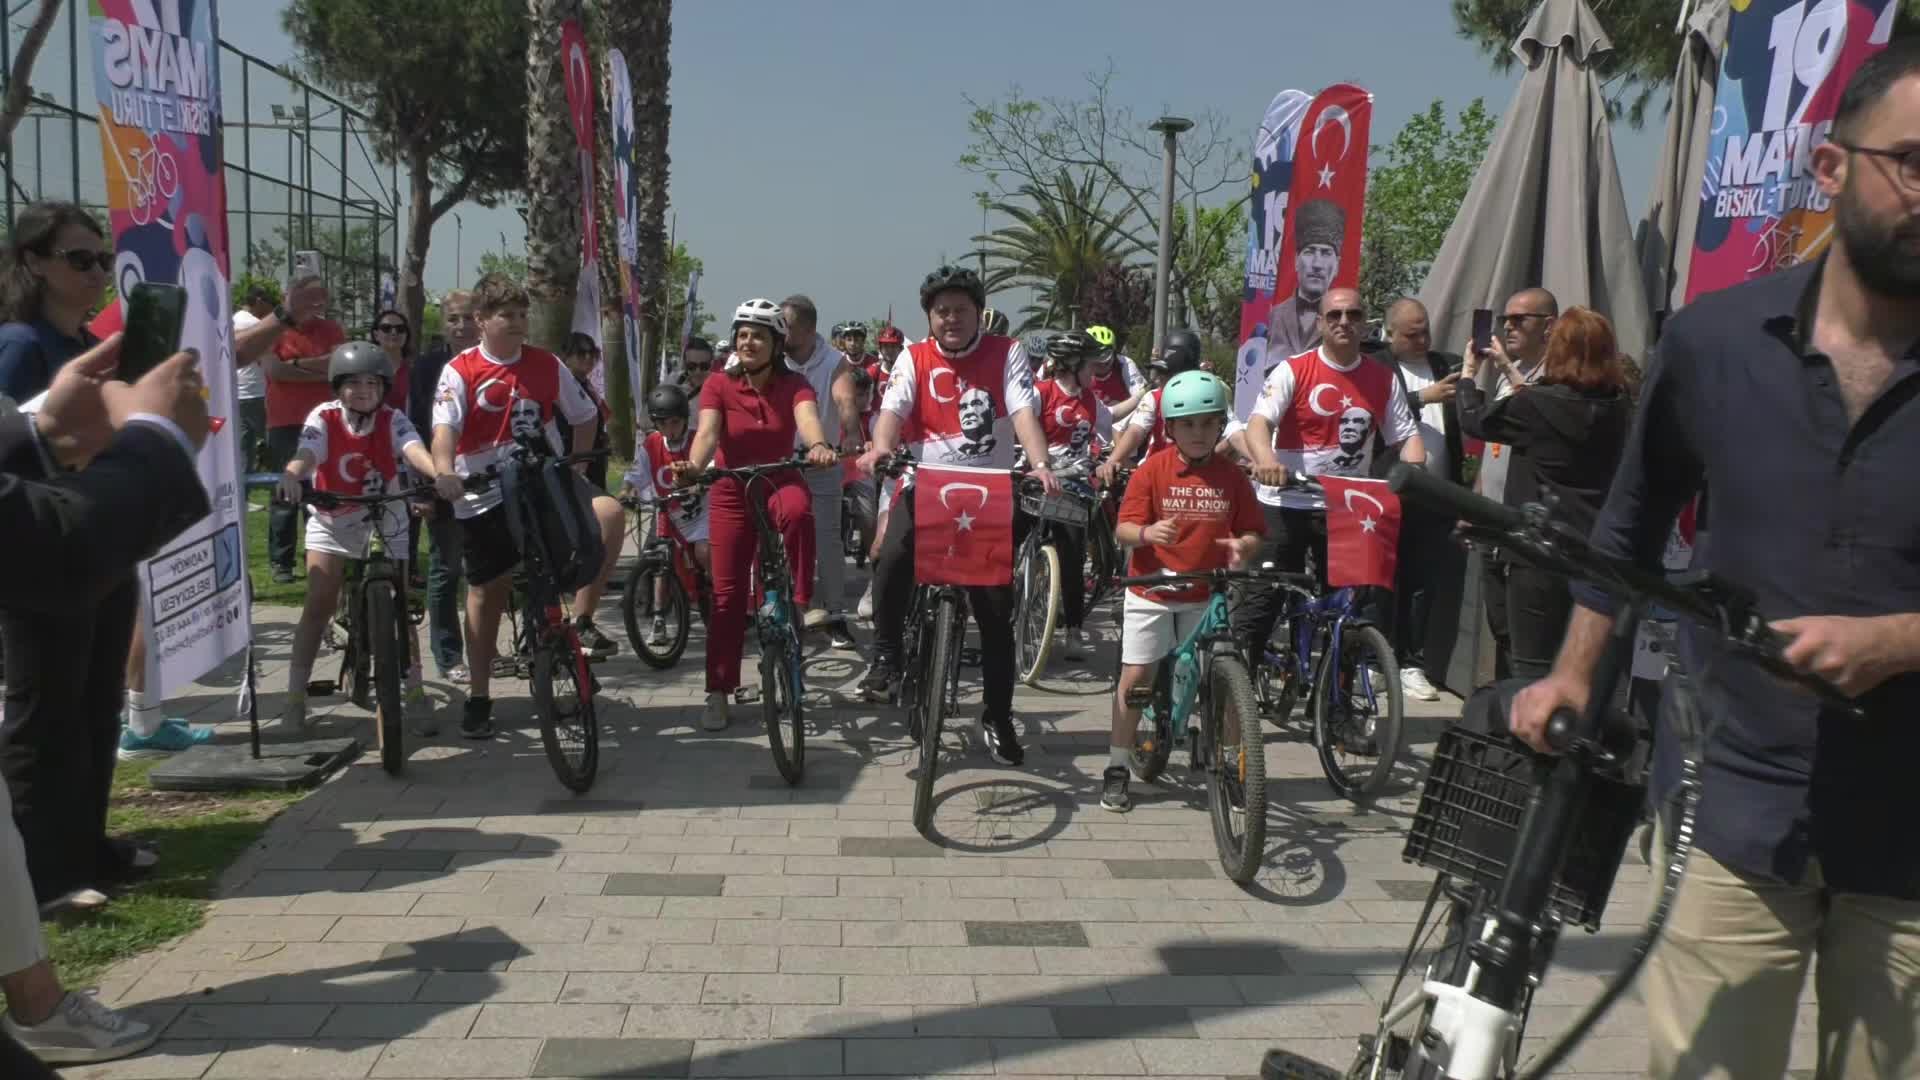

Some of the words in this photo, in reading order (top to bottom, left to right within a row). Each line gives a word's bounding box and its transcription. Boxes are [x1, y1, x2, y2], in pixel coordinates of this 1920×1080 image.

[1761, 0, 1848, 131] 19
[1714, 186, 1777, 218] BİSİKLE
[1169, 486, 1193, 496] THE
[1195, 487, 1224, 497] ONLY
[1162, 497, 1187, 508] WAY
[1196, 499, 1230, 509] KNOW
